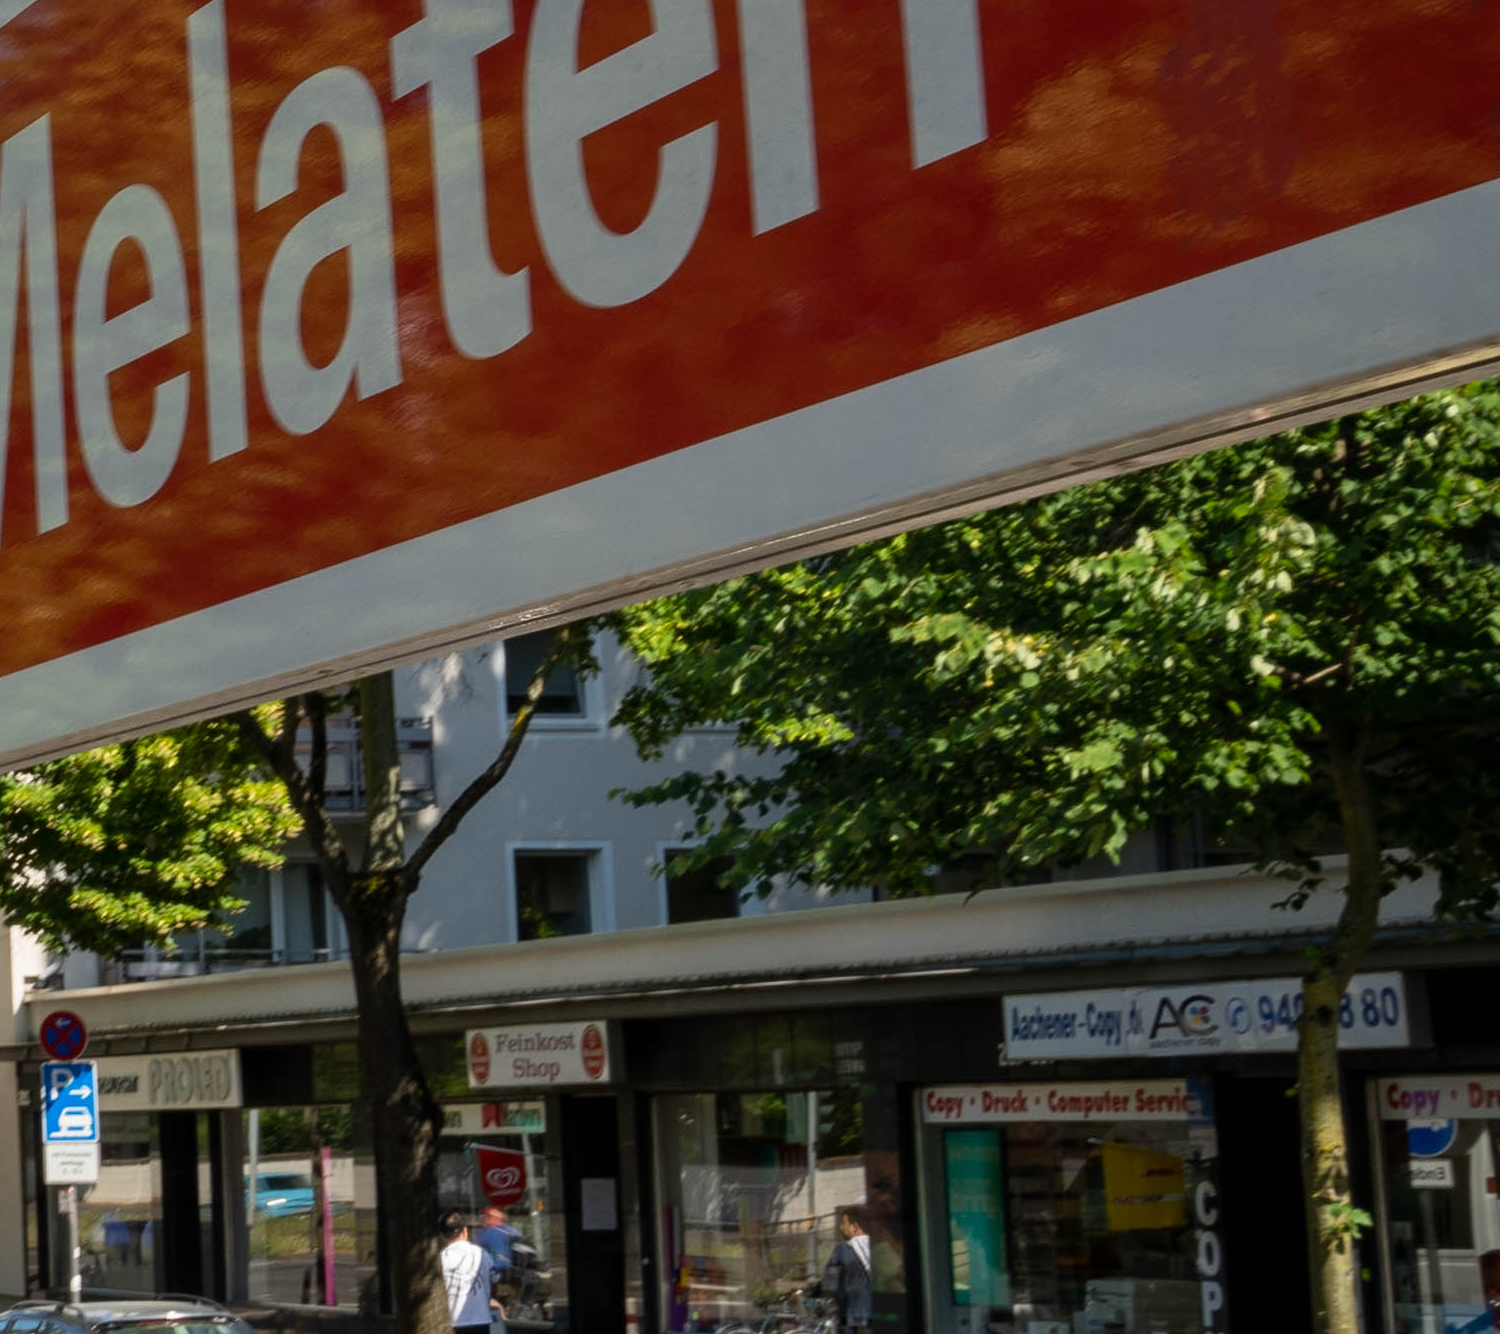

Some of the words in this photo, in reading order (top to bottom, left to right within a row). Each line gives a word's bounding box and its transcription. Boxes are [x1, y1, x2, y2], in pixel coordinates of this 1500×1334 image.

[1010, 998, 1122, 1046] Aachener-Copy
[1148, 994, 1220, 1040] AC
[1361, 986, 1398, 1027] 80
[495, 1032, 576, 1053] Feinkost
[512, 1057, 560, 1080] Shop
[926, 1090, 964, 1119] Copy
[981, 1088, 1029, 1112] Druck
[1047, 1088, 1130, 1119] Computer
[1134, 1086, 1189, 1112] Servic
[1387, 1082, 1439, 1116] Copy
